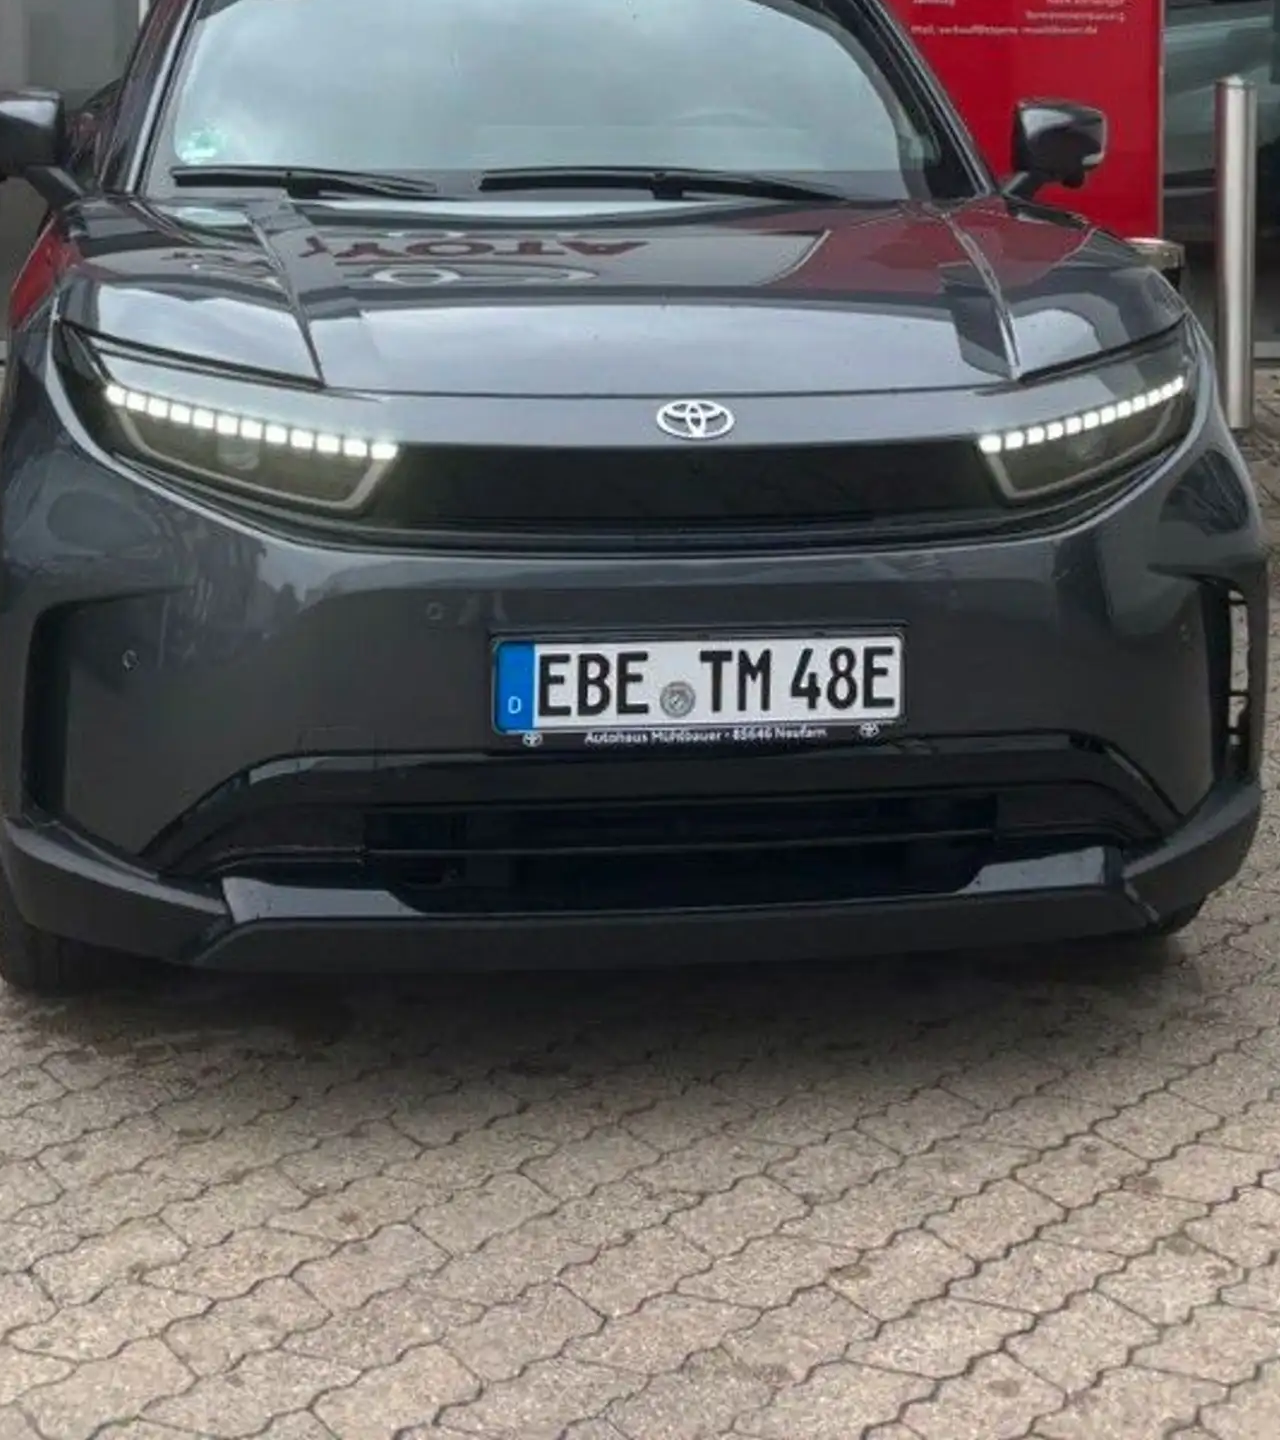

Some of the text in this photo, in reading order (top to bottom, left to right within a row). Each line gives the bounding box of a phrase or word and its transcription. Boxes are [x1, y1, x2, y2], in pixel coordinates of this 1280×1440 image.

[537, 646, 896, 718] EBE TM 48E
[507, 696, 522, 714] D
[584, 732, 649, 745] Autohaus
[651, 729, 723, 742] Mühlbauer
